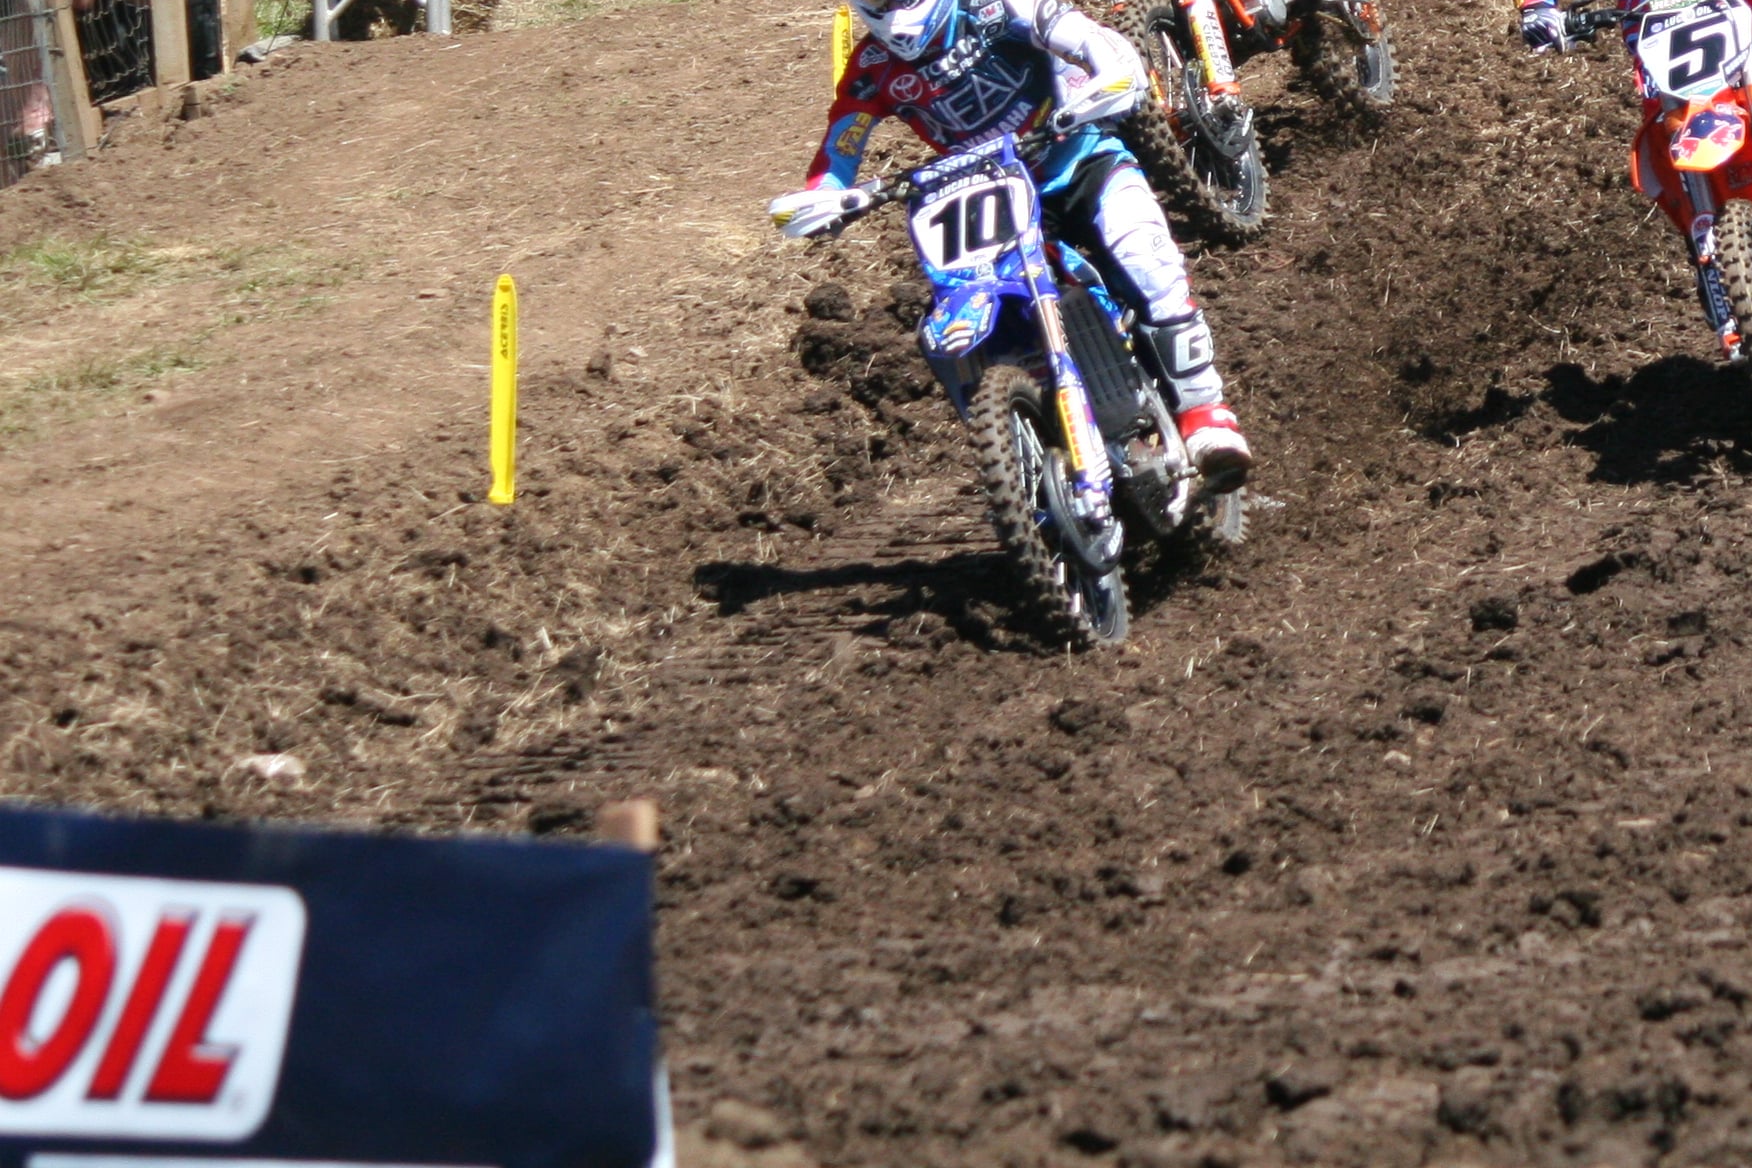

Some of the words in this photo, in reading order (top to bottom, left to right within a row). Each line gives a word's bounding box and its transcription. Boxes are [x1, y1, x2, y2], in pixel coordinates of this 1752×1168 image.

[1696, 5, 1713, 18] OIL
[1668, 13, 1727, 91] 5
[963, 100, 1034, 150] YAMAHA
[938, 177, 970, 198] LUCAS
[929, 186, 1017, 267] 10
[500, 303, 509, 359] ACERBIS
[0, 895, 258, 1105] OIL
